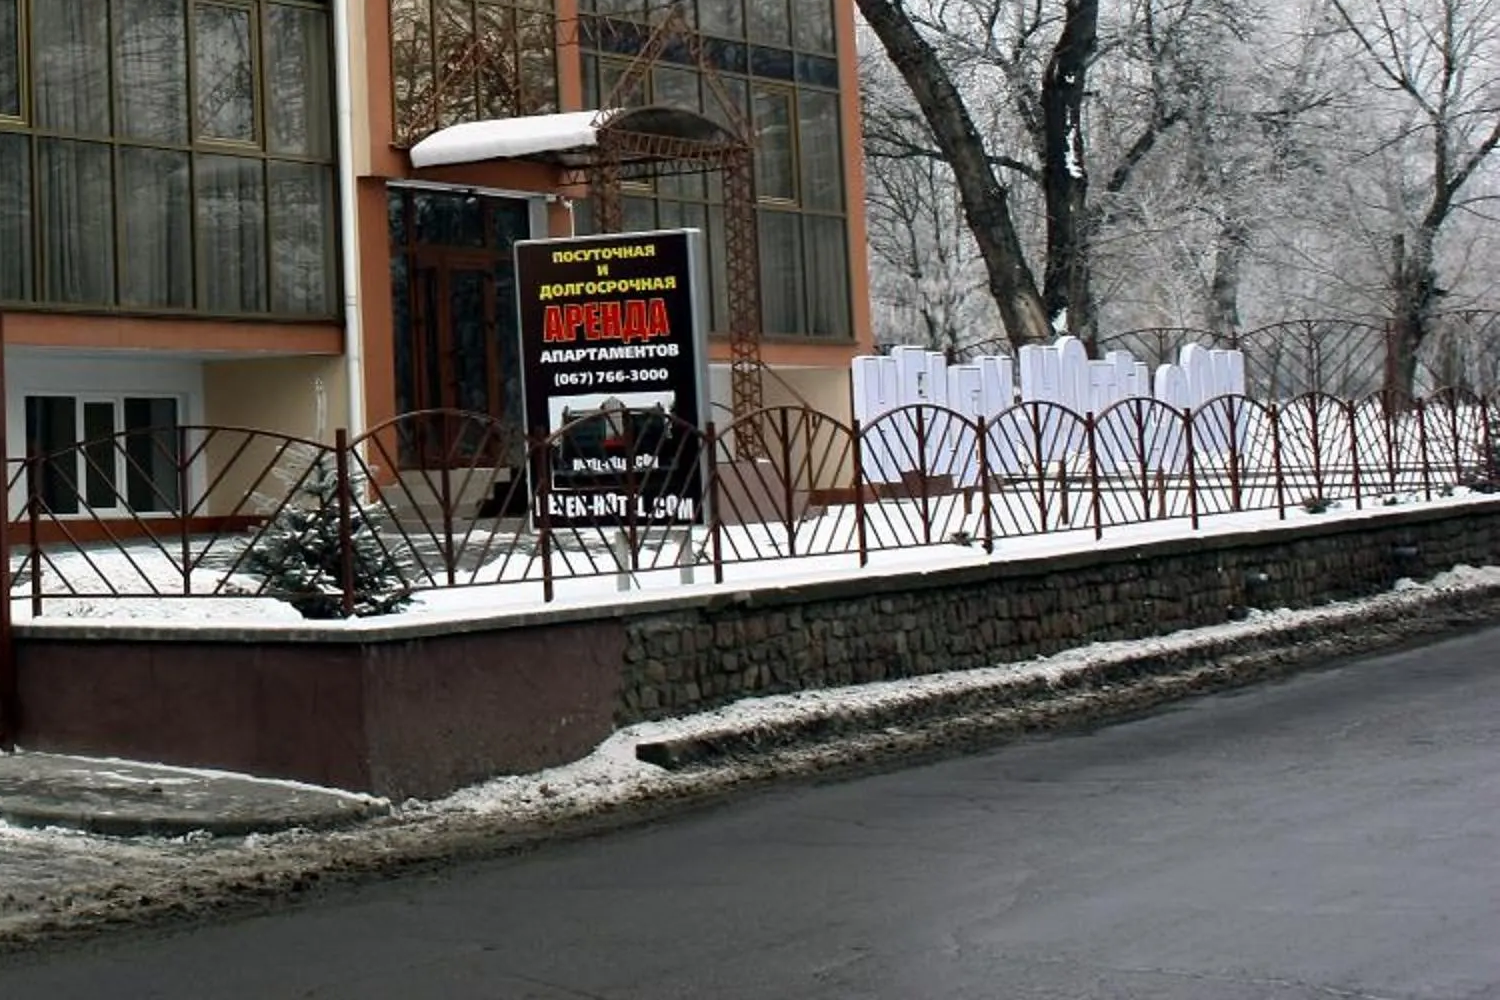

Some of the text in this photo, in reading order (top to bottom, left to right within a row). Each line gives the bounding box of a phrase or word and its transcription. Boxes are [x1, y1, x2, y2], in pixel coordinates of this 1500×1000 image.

[552, 244, 656, 263] ПОСУТОЧНАЯ
[597, 264, 609, 276] И
[540, 276, 677, 300] ДОЛГОСРОЧНАЯ
[543, 298, 670, 344] АРЕНДА
[540, 343, 680, 363] АПАРТАМЕНТОВ
[554, 368, 669, 387] (067) 766-3000
[535, 492, 694, 521] ELEN-HOTL.COM
